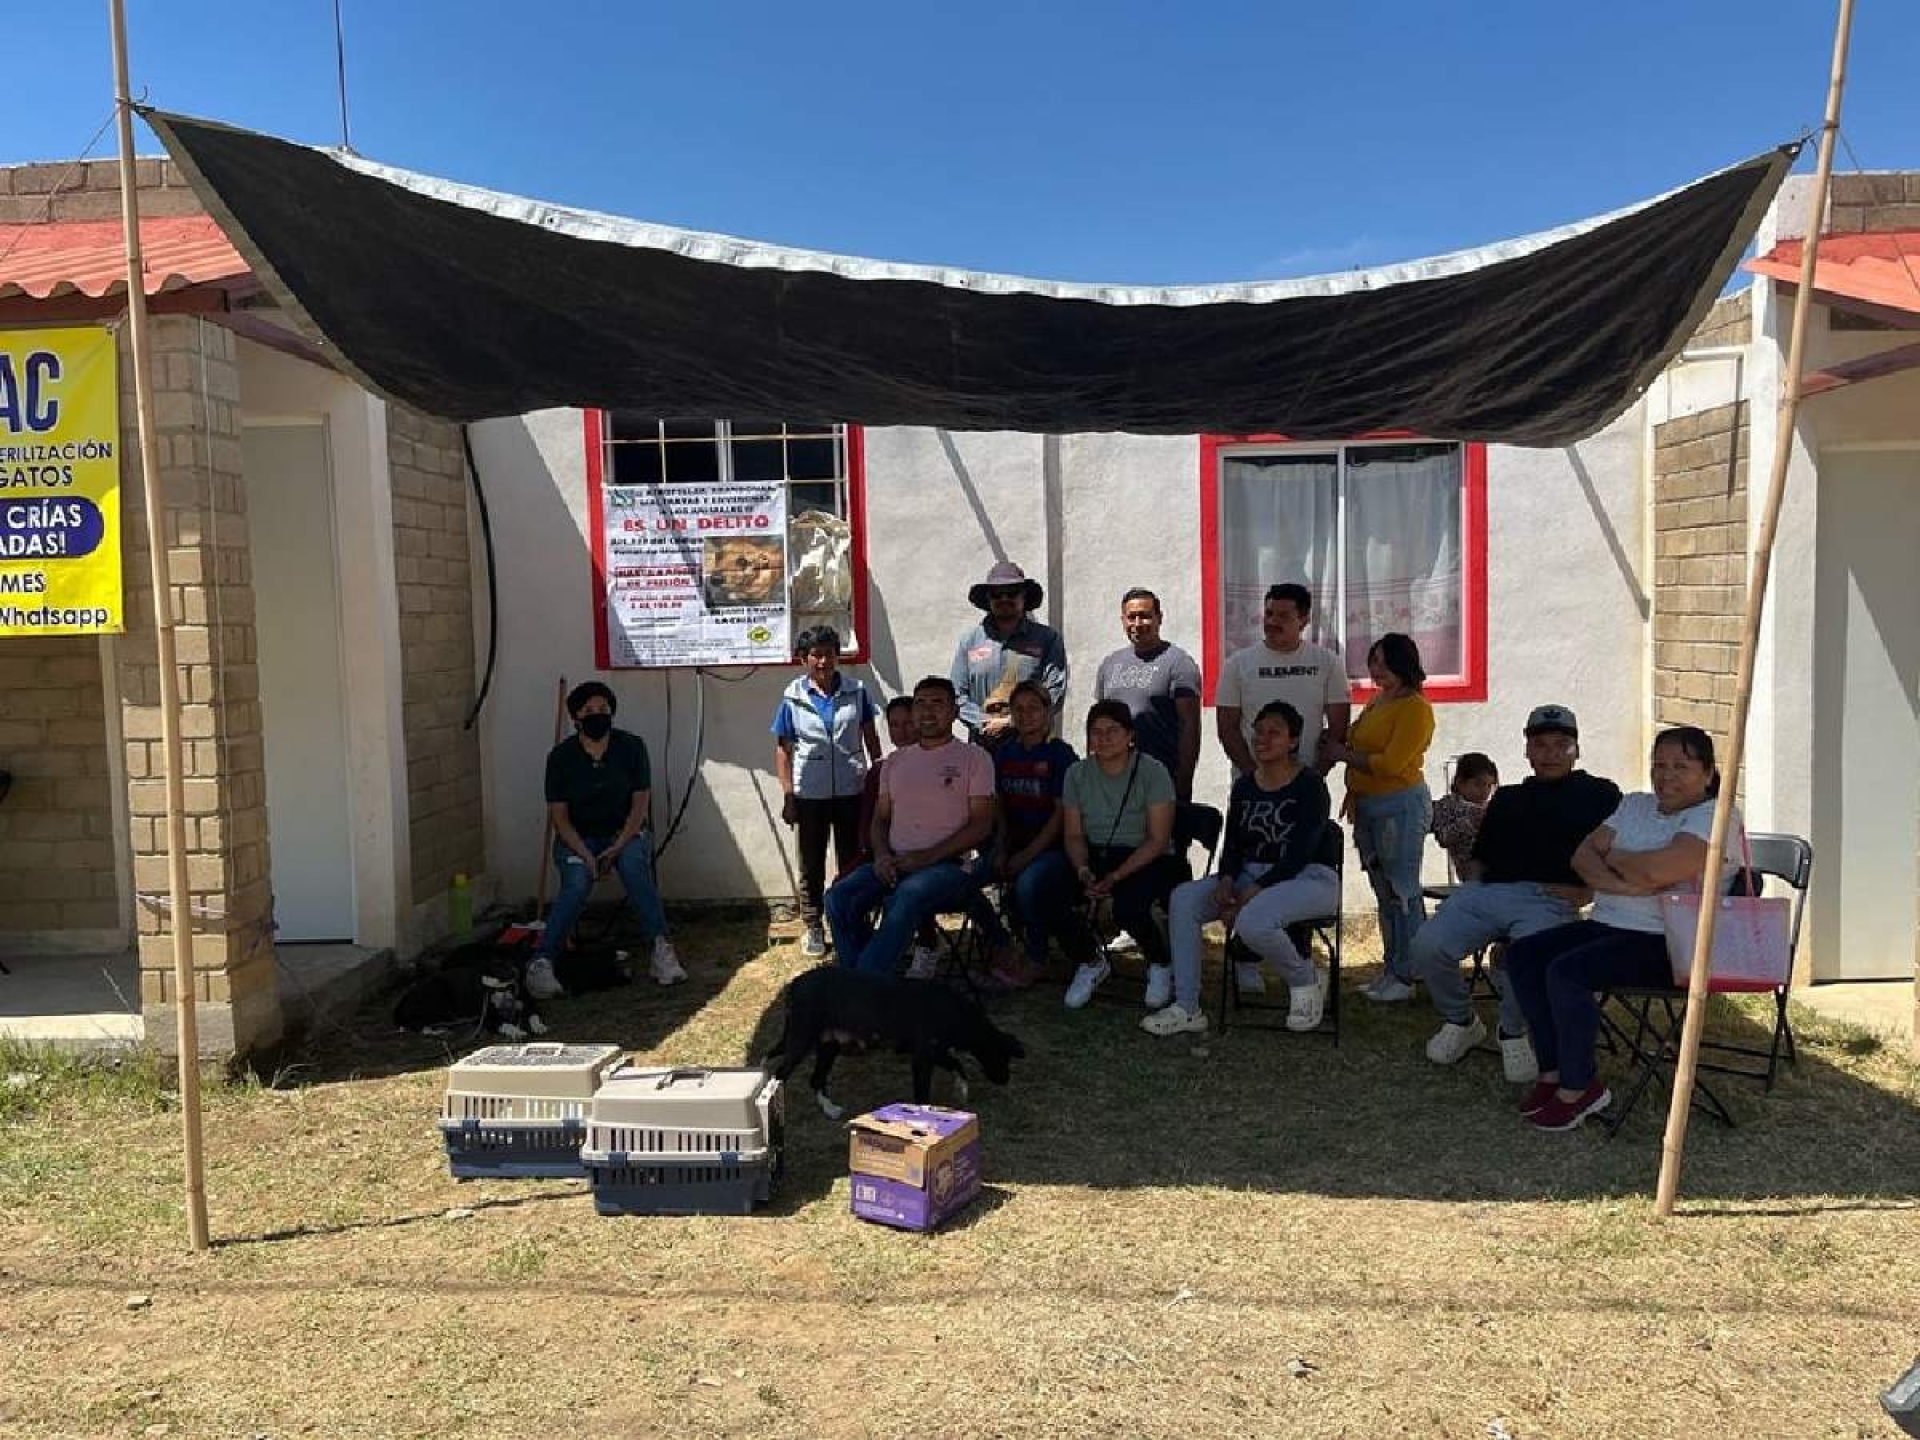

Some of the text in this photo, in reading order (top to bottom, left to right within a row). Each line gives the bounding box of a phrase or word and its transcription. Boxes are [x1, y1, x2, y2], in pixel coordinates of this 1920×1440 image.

[0, 352, 60, 433] AC
[0, 441, 112, 462] ERILIZACIÓN
[7, 499, 82, 529] CRÍAS
[623, 515, 769, 532] ES UN DELITO
[1, 573, 45, 594] MES
[0, 605, 108, 628] Whatsapp
[1258, 665, 1319, 679] ELEMENT
